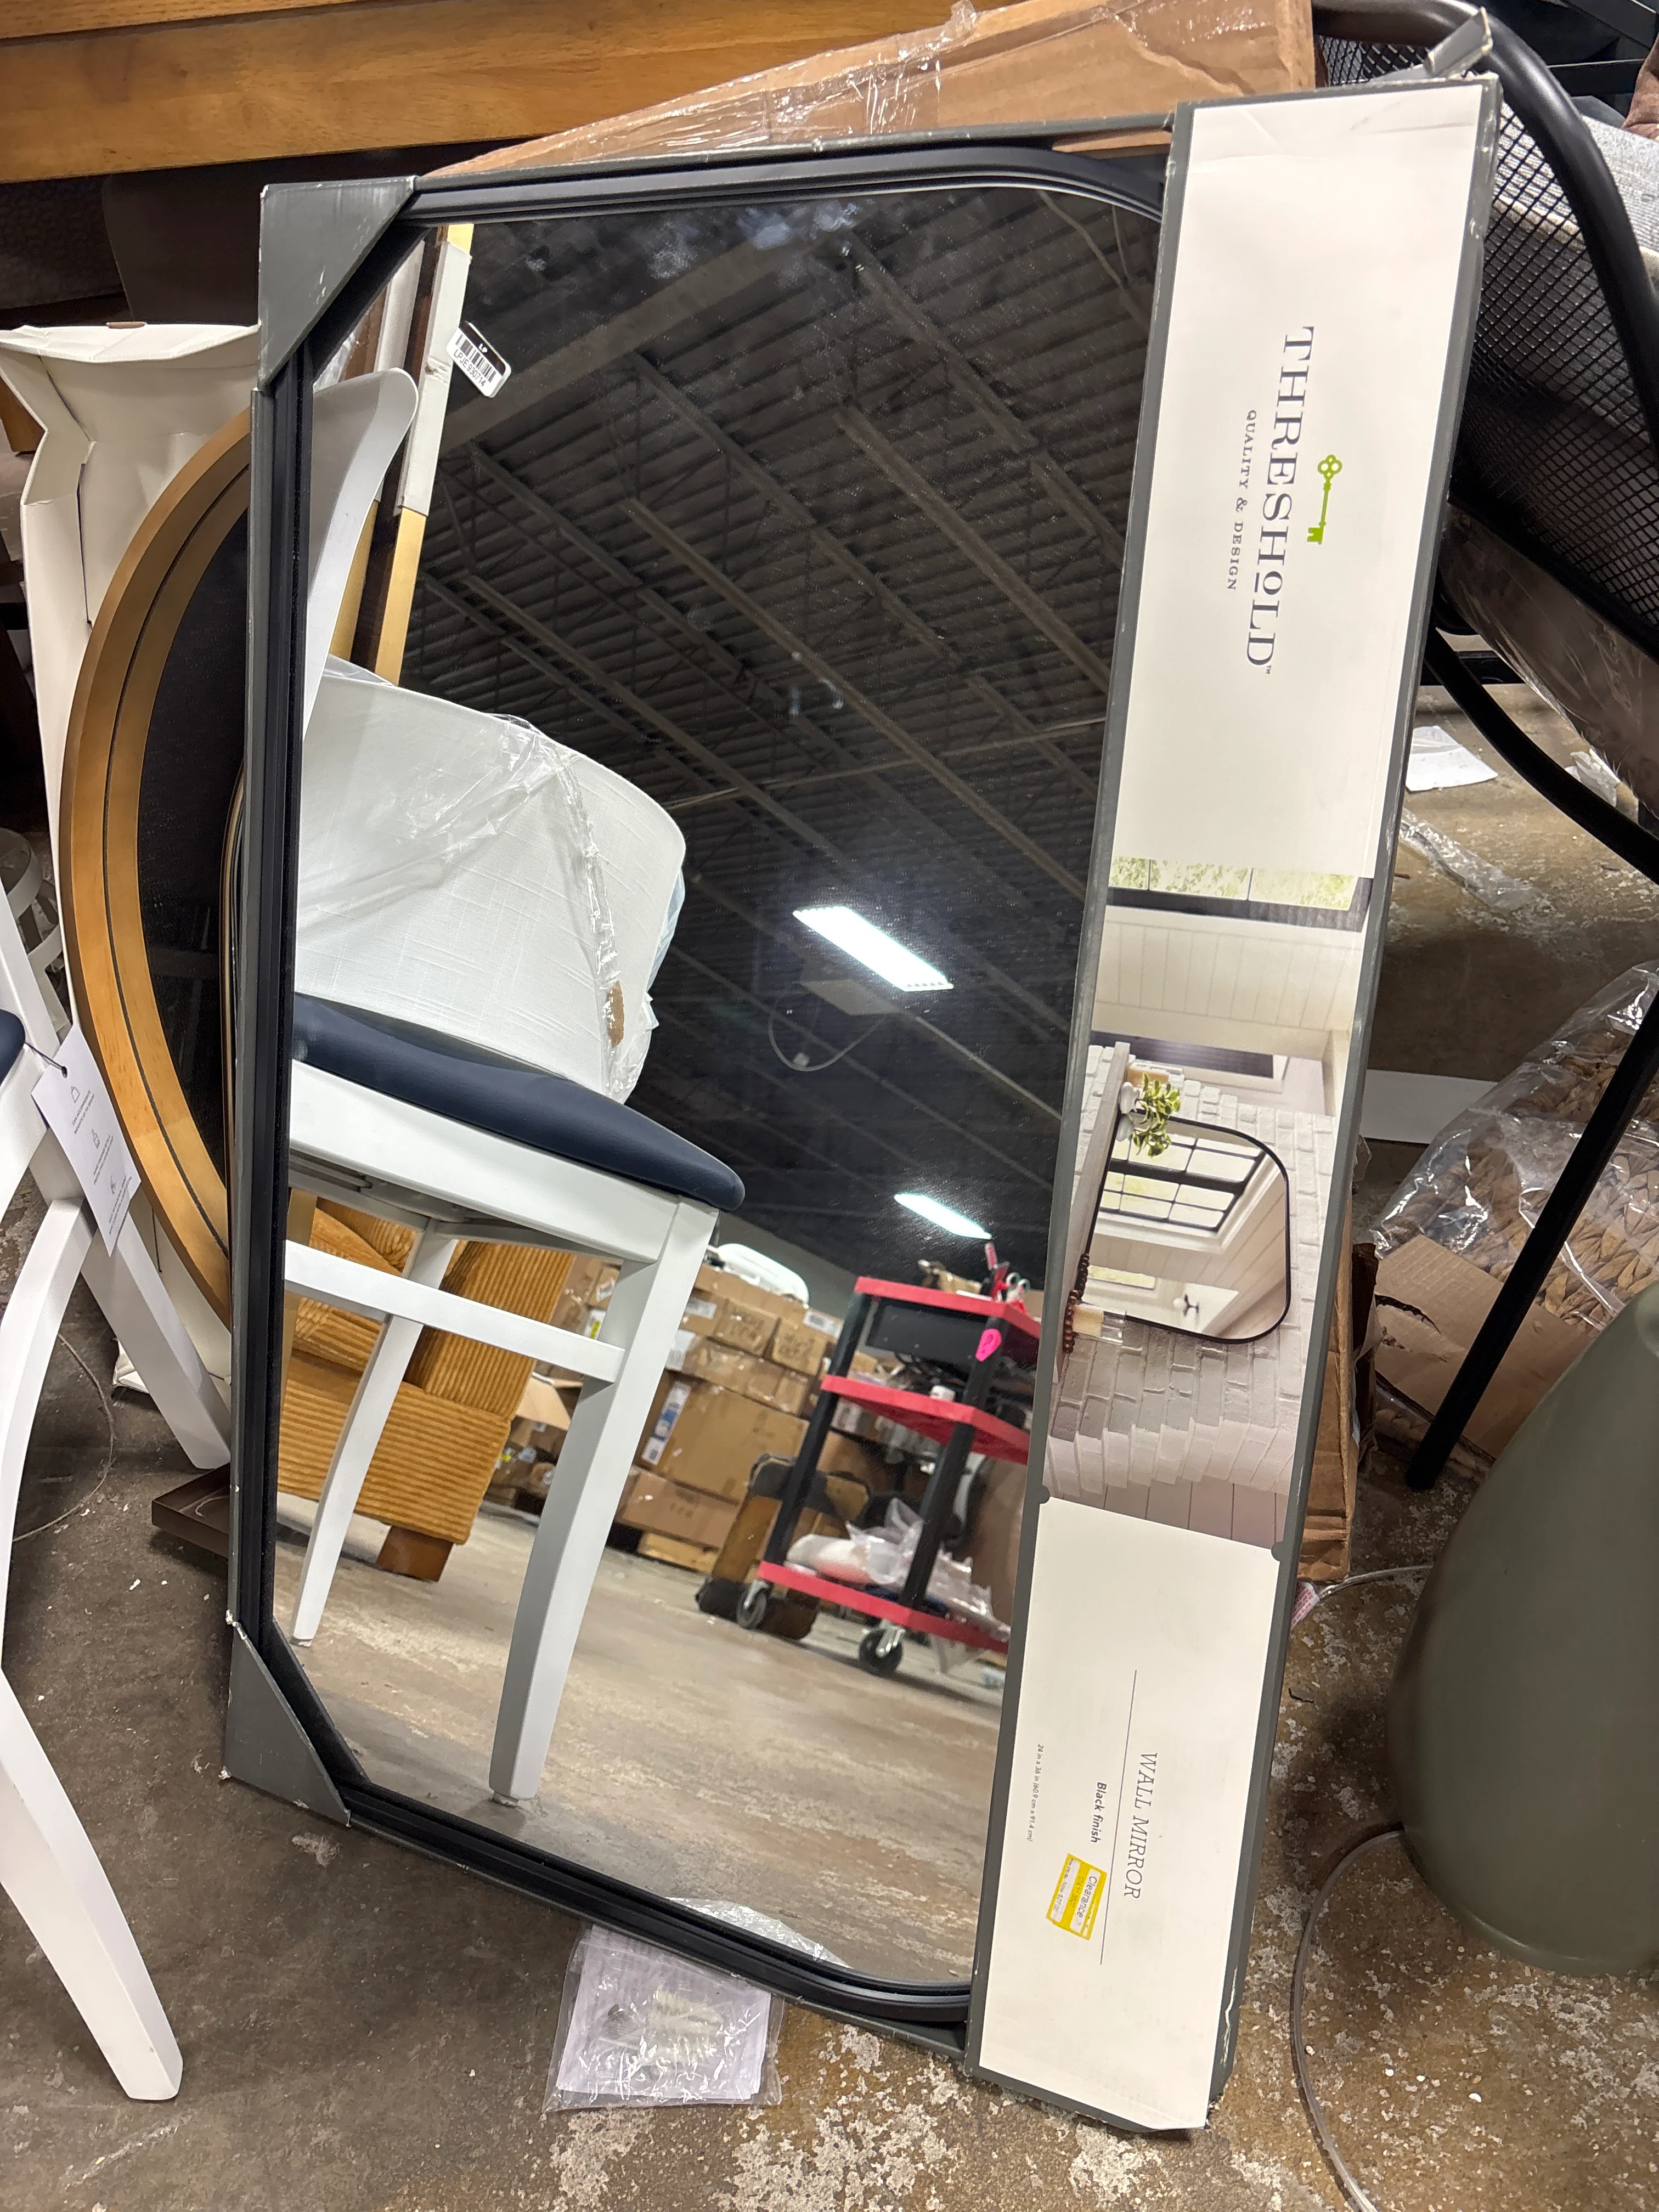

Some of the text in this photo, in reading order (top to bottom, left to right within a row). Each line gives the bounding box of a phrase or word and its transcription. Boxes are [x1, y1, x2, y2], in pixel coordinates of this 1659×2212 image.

[479, 343, 488, 353] LP
[1227, 409, 1257, 591] QUALITY & DESIGN
[1090, 1781, 1107, 1843] Black finish
[1124, 1752, 1158, 1899] WALL MIRROR
[1076, 1875, 1097, 1918] Clearance
